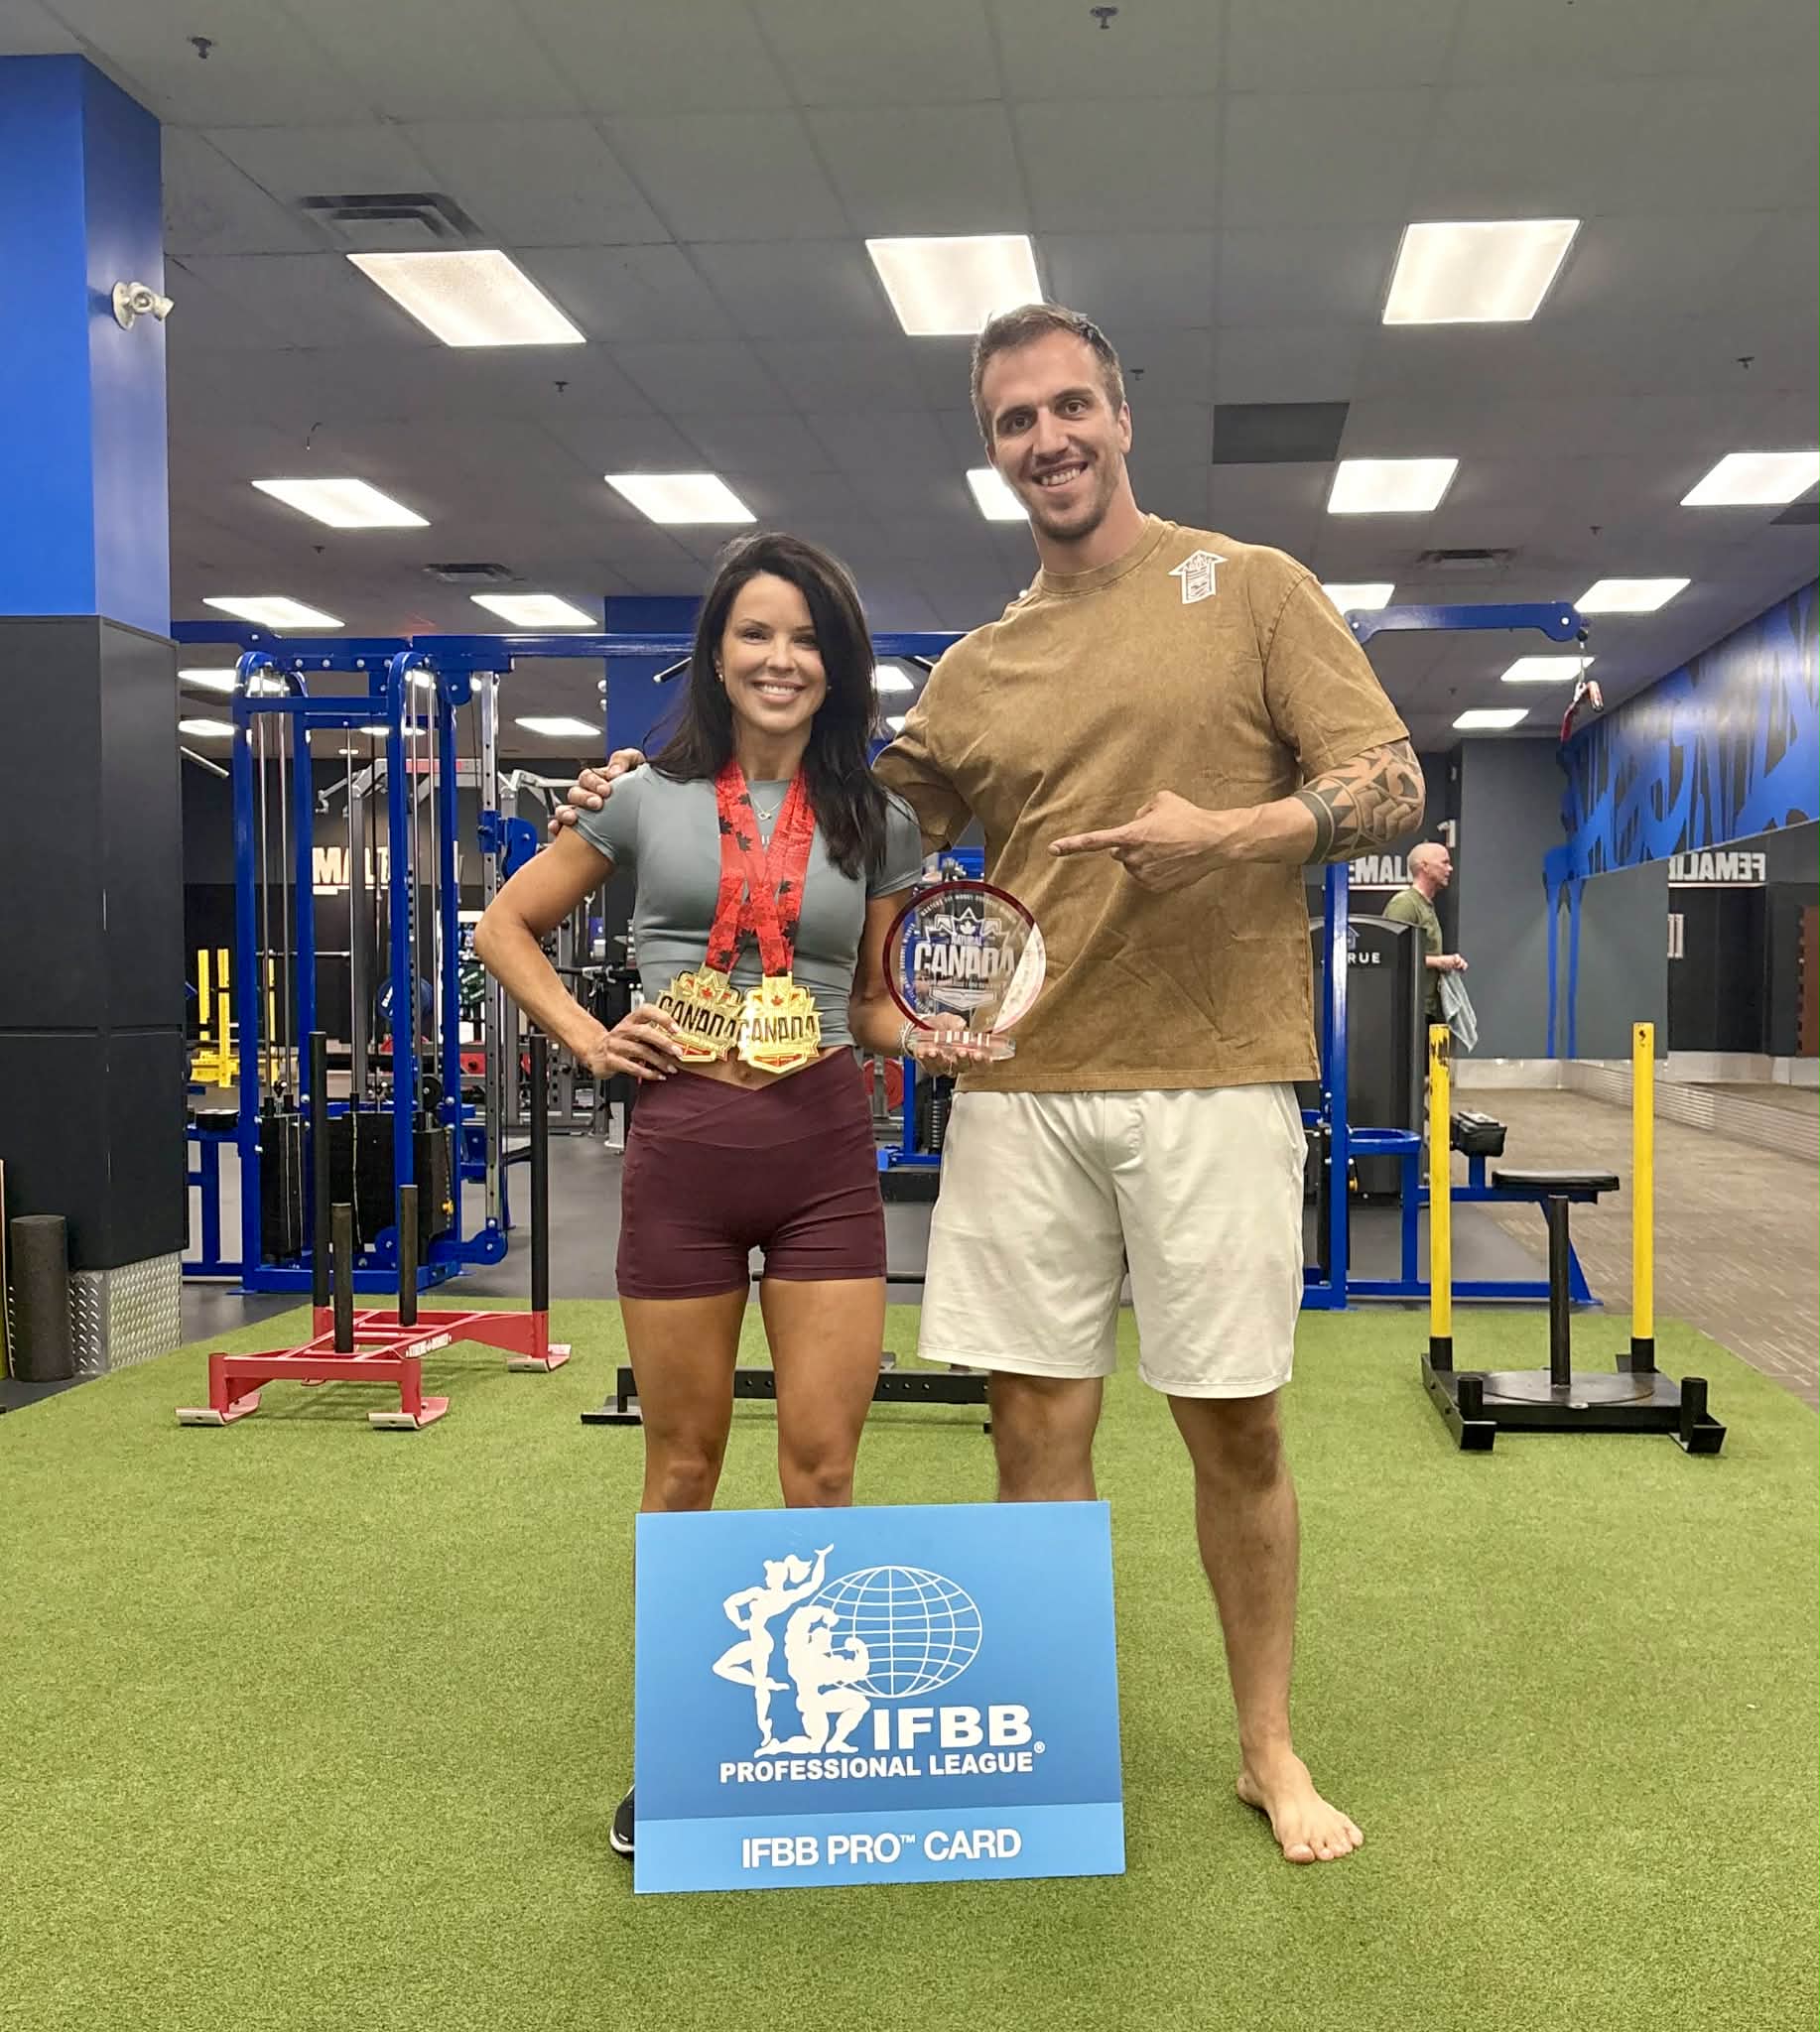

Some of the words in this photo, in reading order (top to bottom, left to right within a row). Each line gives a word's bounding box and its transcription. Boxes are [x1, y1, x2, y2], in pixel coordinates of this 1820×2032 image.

[914, 943, 1016, 979] CANADA
[1348, 952, 1381, 963] RUE
[719, 1755, 922, 1784] PROFESSIONAL
[929, 1751, 1033, 1776] LEAGUE
[742, 1837, 820, 1868] IFBB
[924, 1829, 1022, 1861] CARD
